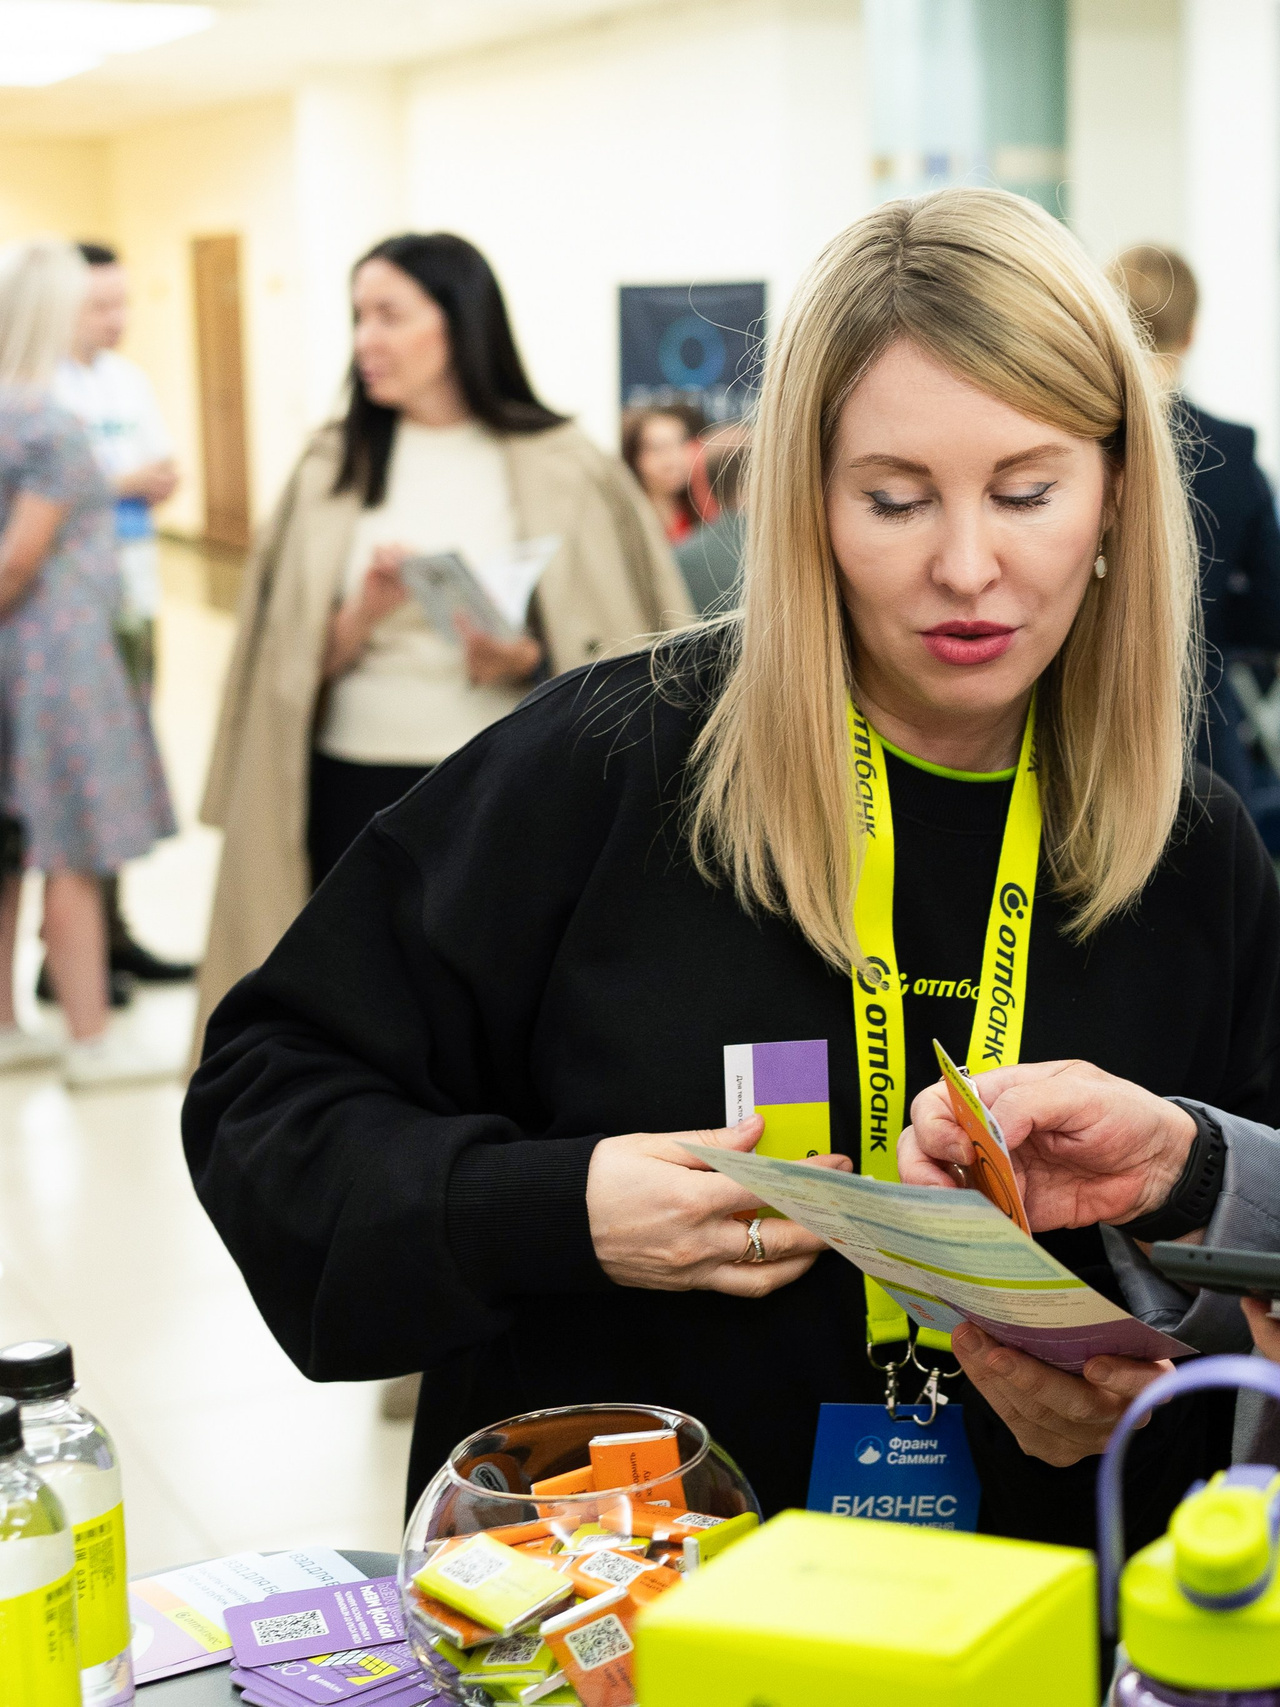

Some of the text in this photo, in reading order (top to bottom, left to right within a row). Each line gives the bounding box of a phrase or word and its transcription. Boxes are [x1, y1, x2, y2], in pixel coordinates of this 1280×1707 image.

[982, 924, 1016, 1066] отпбанк
[866, 1003, 894, 1153] отпбанк
[889, 1436, 939, 1452] Франч
[886, 1452, 948, 1465] Саммит
[630, 1452, 641, 1498] оормить
[831, 1495, 958, 1517] БИЗНЕС
[359, 1584, 383, 1608] МЕРЧ
[366, 1607, 396, 1639] КРУТОЙ
